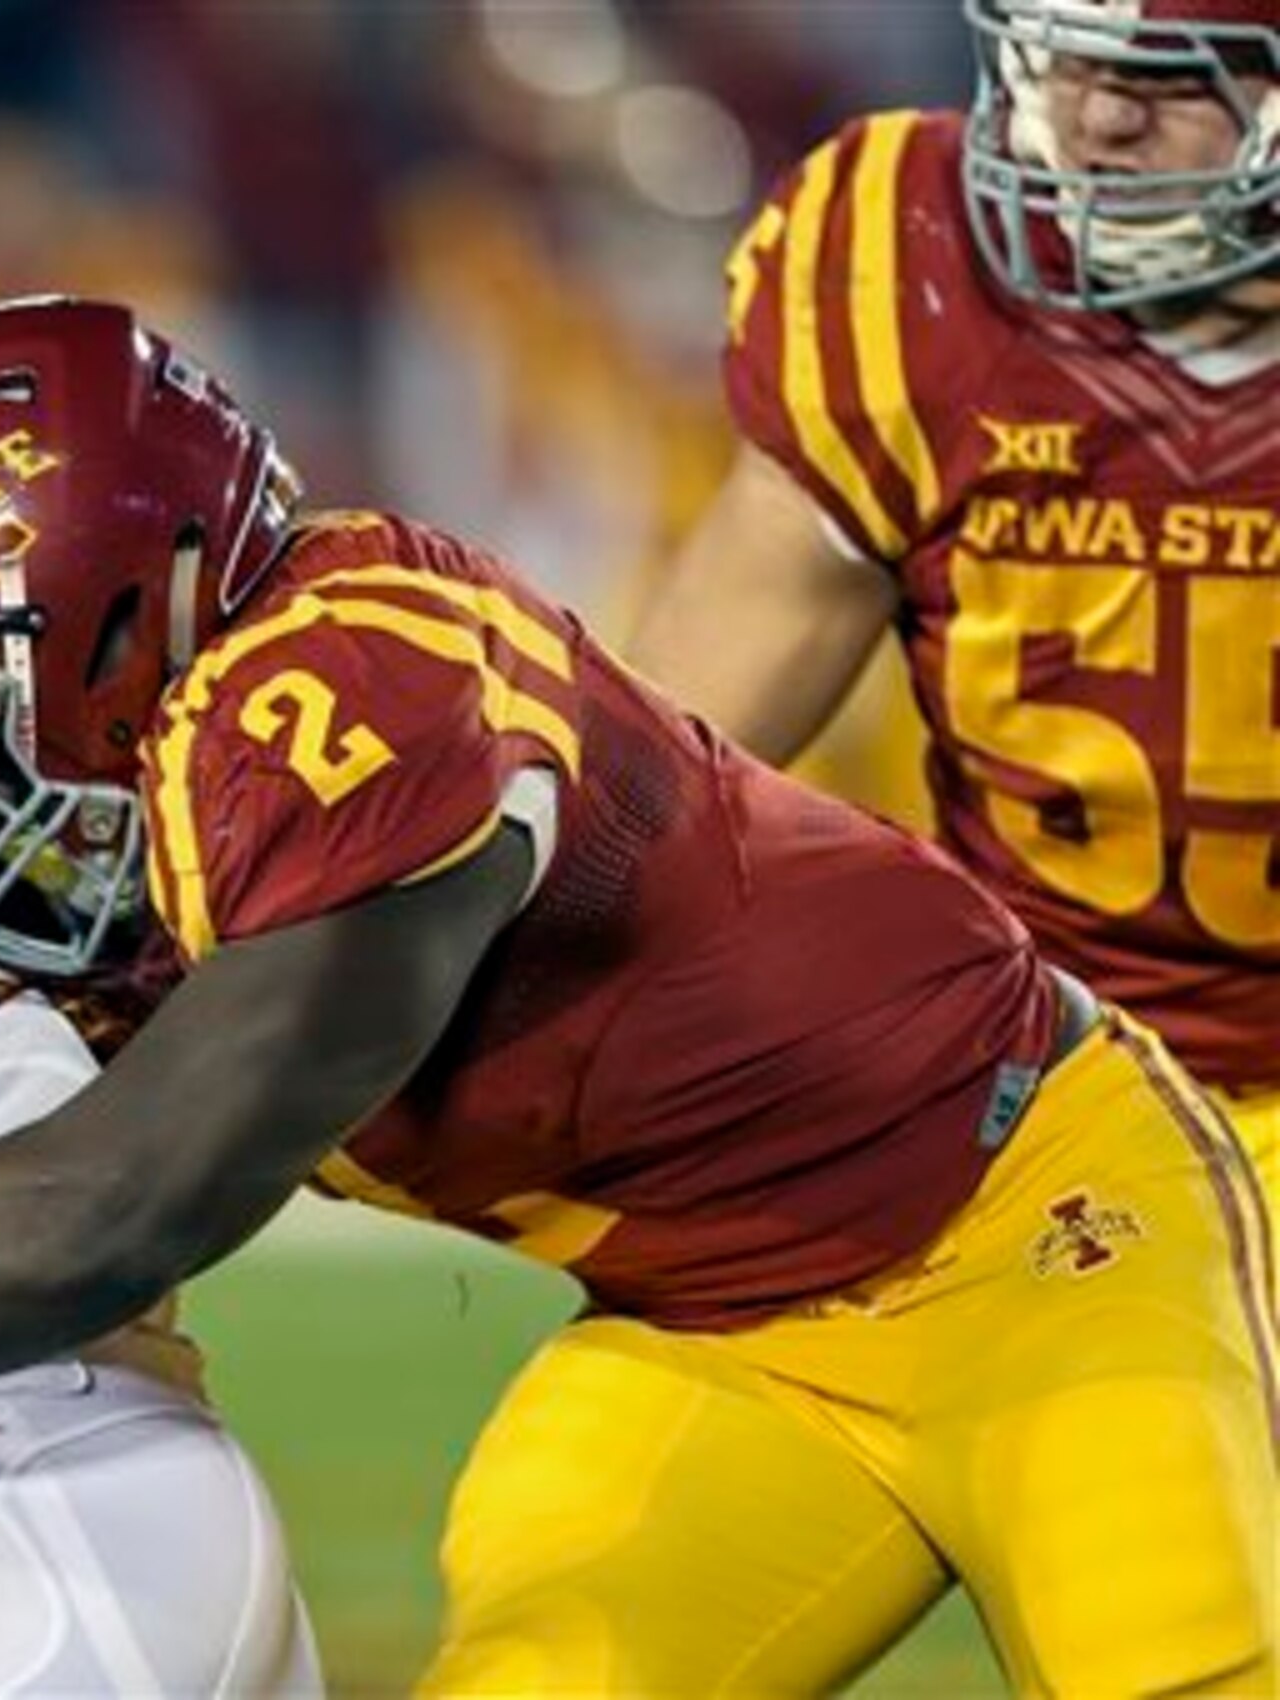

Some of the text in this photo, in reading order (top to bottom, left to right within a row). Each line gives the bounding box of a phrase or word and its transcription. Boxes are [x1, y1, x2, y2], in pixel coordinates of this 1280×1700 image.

[978, 413, 1082, 475] XII
[963, 495, 1280, 568] WA ST
[238, 667, 397, 808] 2
